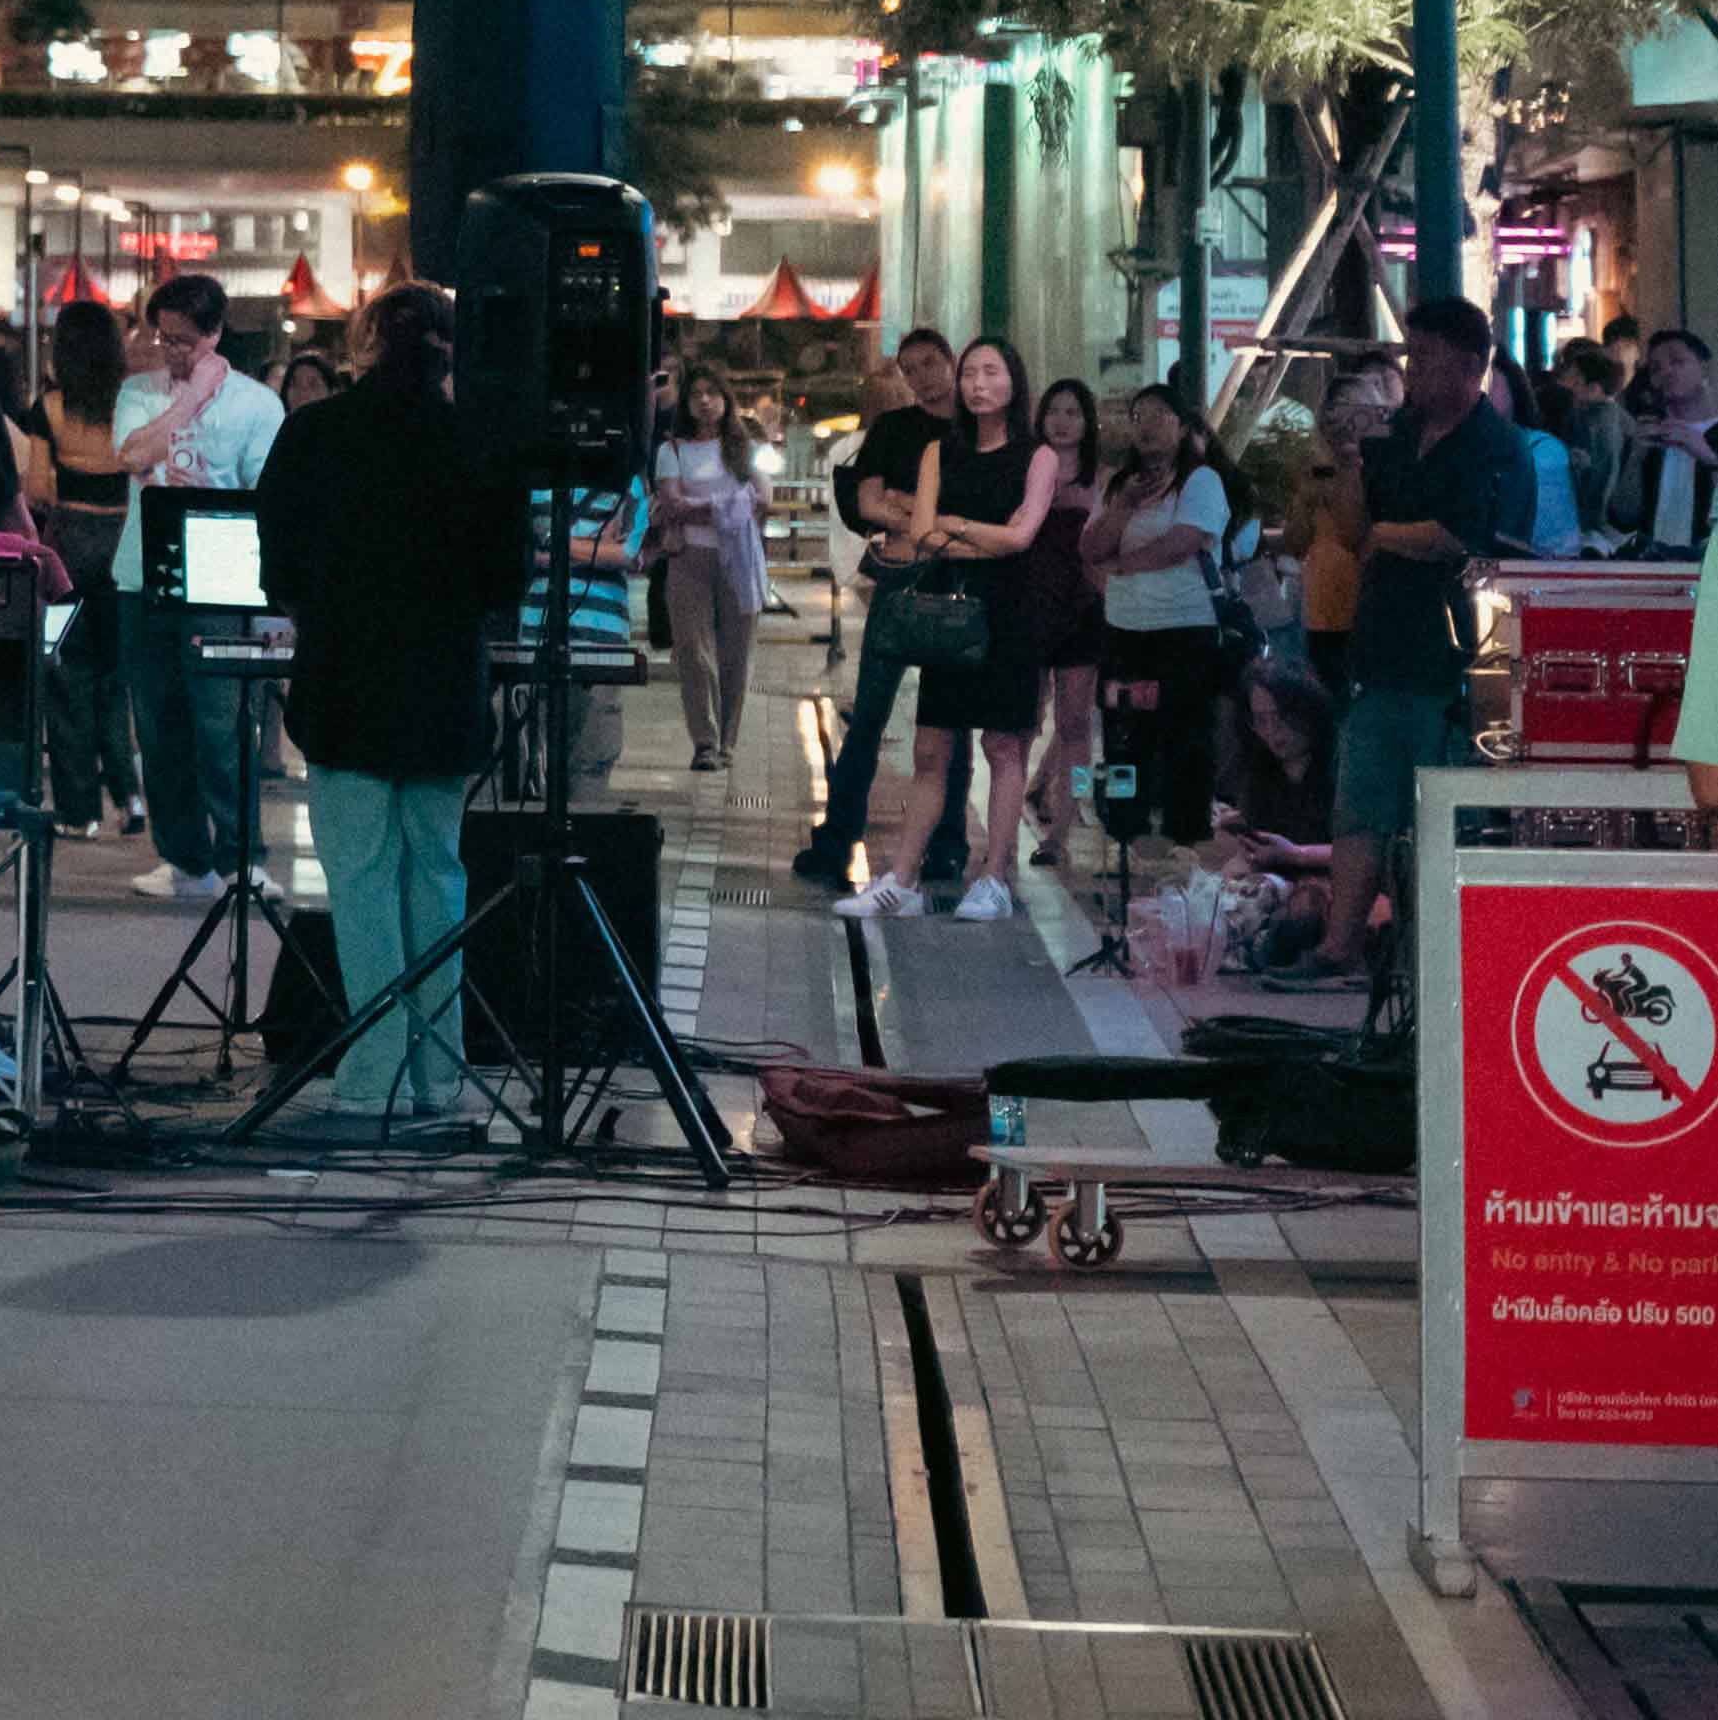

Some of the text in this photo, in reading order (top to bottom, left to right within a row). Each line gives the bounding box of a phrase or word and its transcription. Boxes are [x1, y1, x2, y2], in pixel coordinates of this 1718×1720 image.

[1491, 1249, 1527, 1272] No
[1534, 1251, 1596, 1278] entry
[1627, 1252, 1664, 1274] No
[1675, 1306, 1715, 1325] 500
